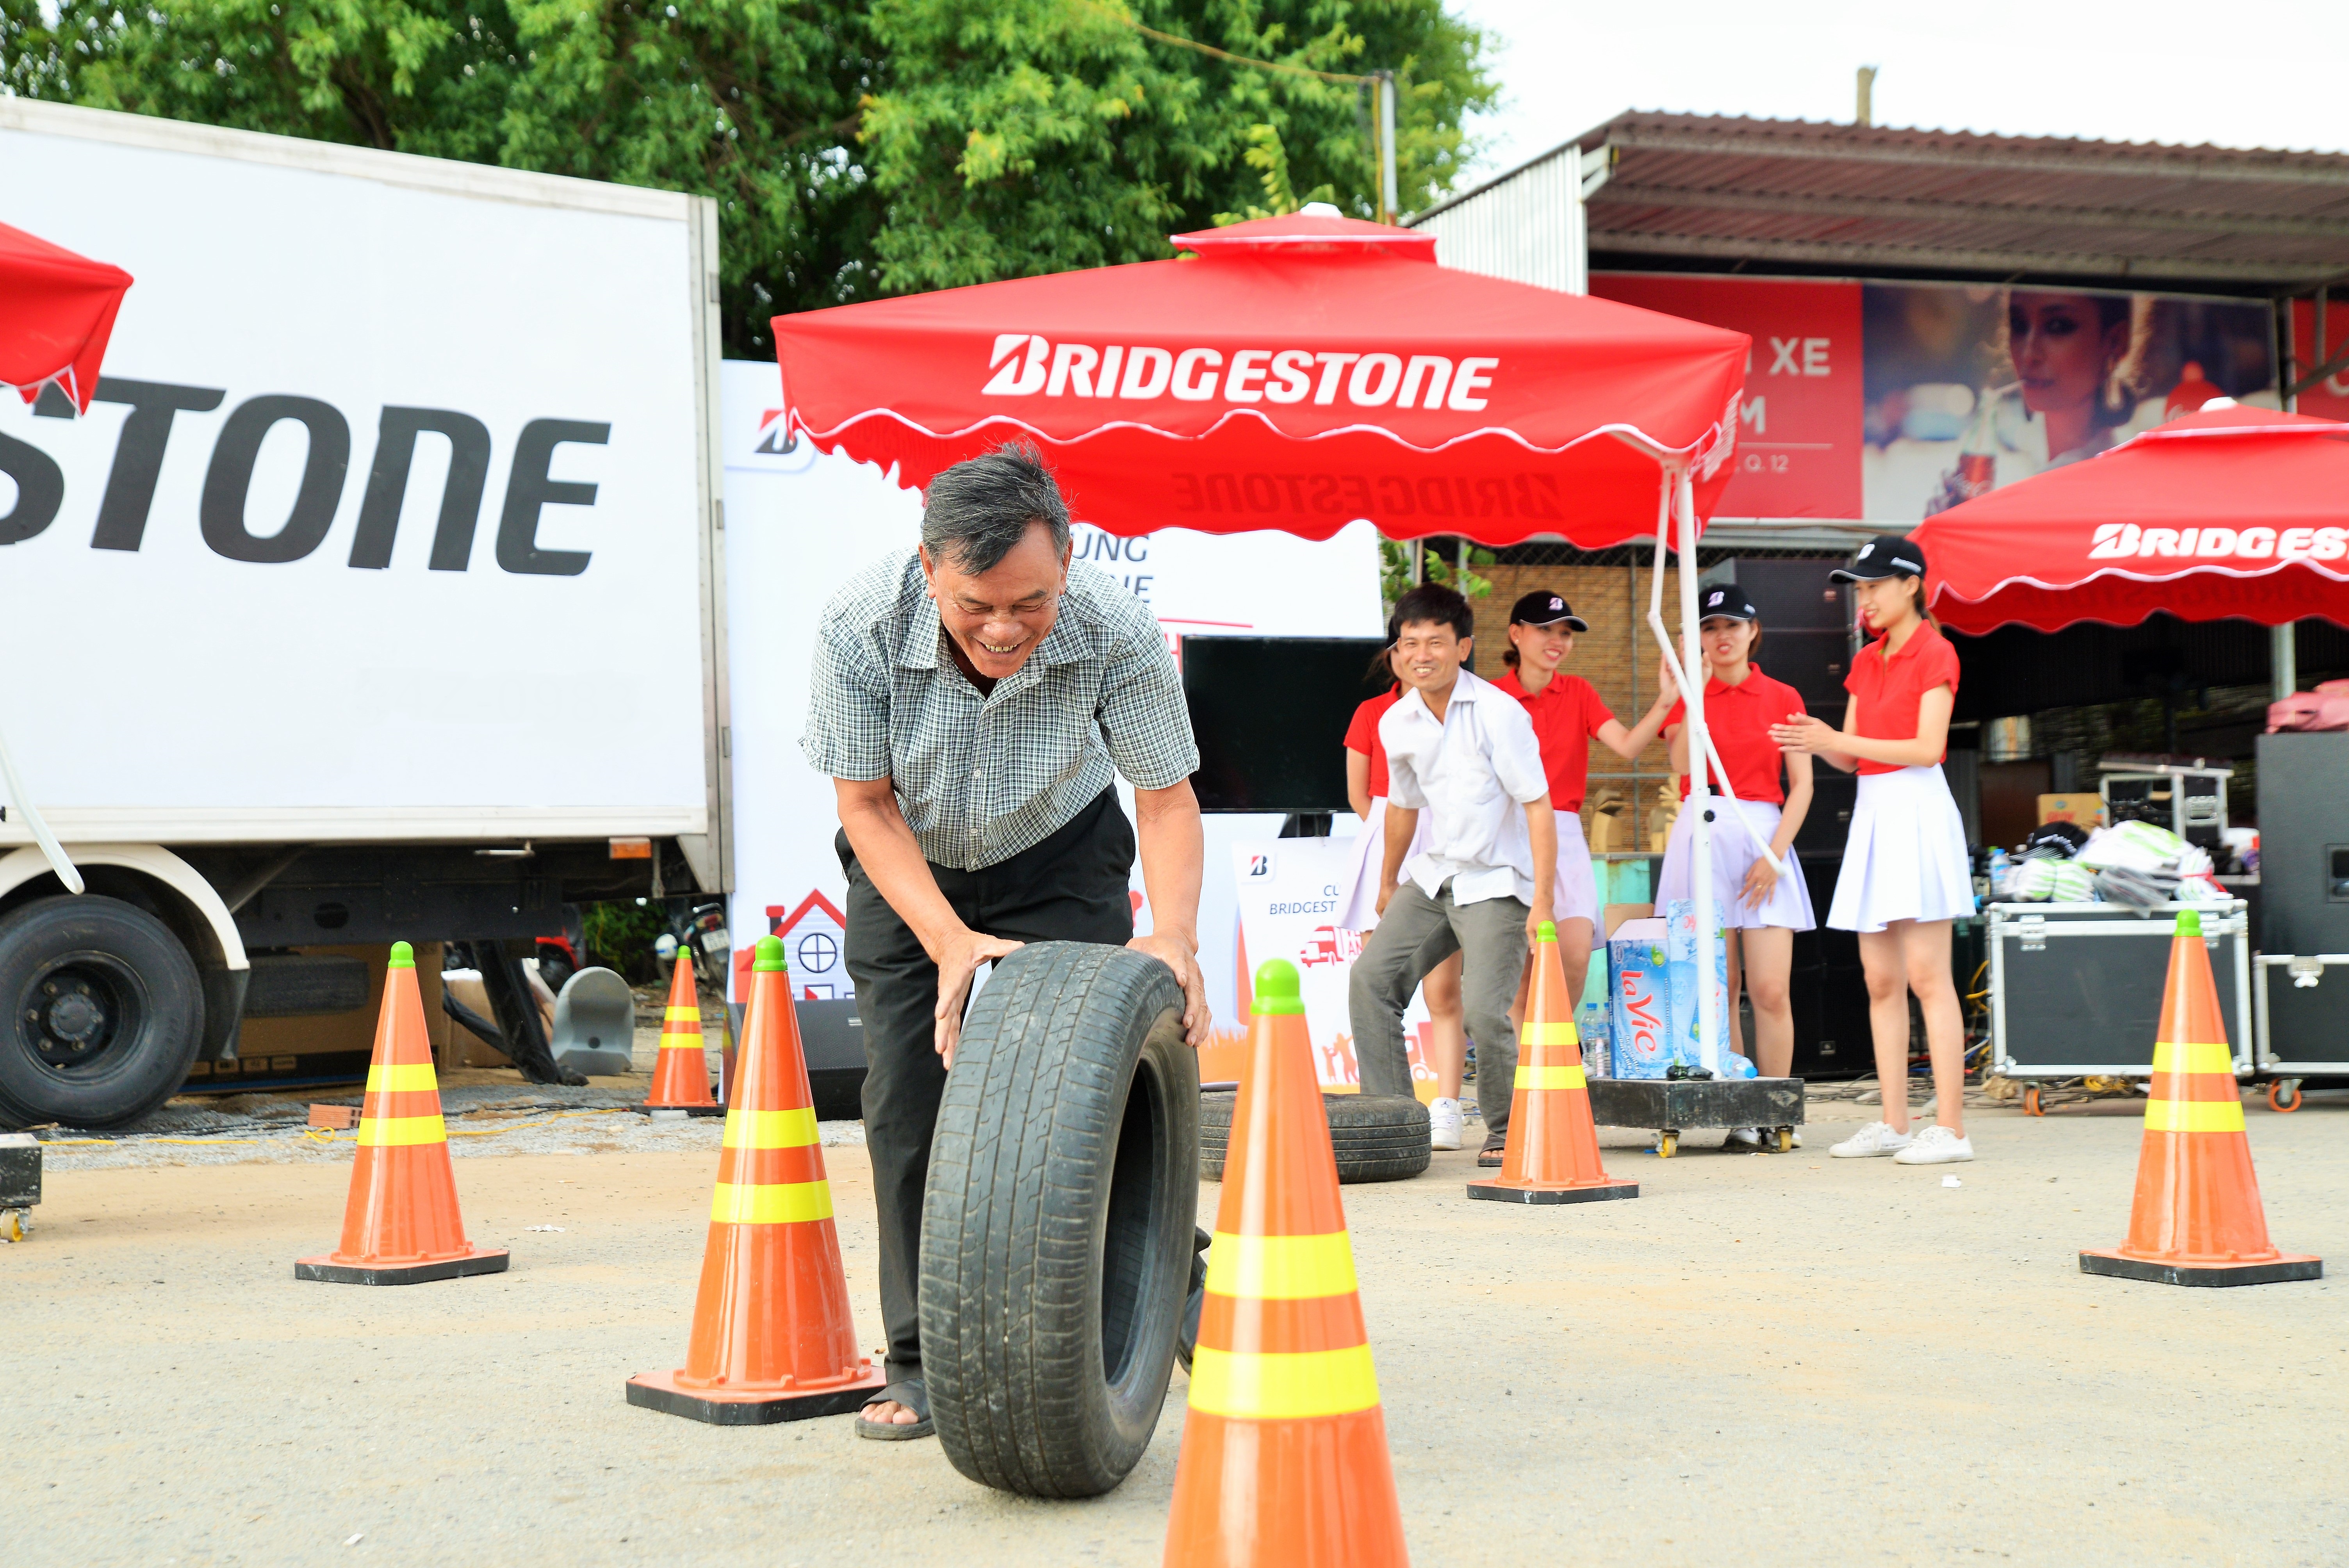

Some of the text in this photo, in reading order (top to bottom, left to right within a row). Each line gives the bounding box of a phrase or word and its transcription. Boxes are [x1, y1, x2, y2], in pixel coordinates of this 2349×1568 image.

[982, 334, 1499, 411] BRIDGESTONE
[1769, 337, 1831, 377] XE
[1770, 454, 1789, 474] 12
[2087, 522, 2349, 561] BRIDGES
[1269, 900, 1337, 915] BRIDGEST
